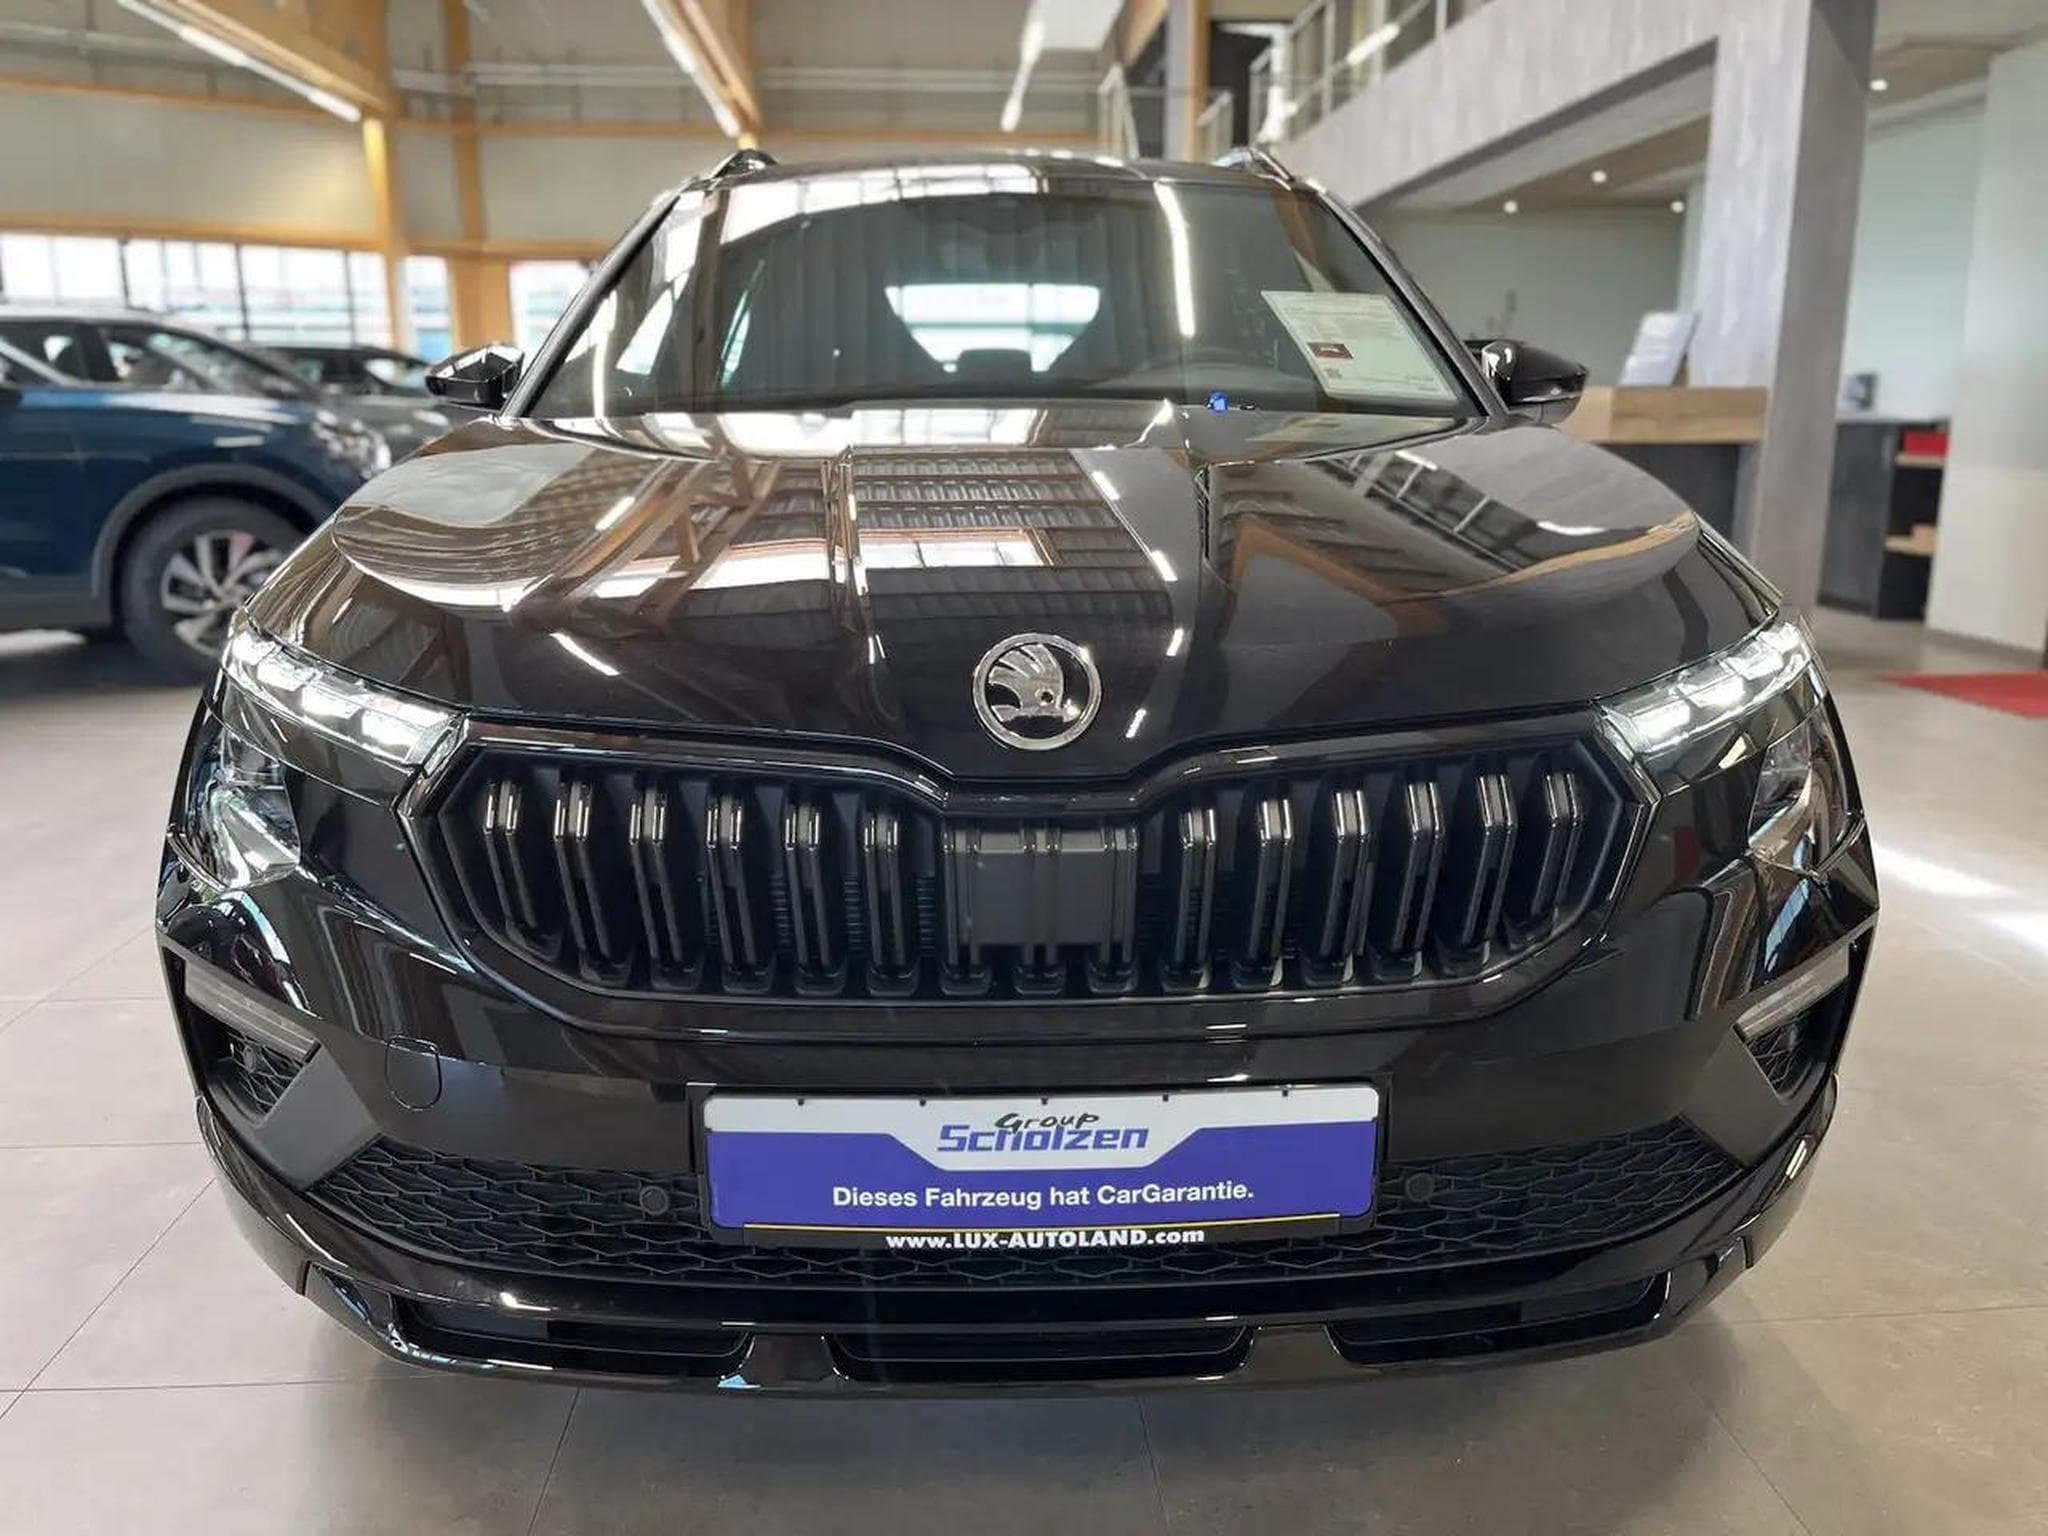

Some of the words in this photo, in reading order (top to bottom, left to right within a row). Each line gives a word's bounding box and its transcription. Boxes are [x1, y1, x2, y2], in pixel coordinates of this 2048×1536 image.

[995, 1112, 1100, 1135] Group
[937, 1124, 1149, 1152] Scholzen
[832, 1187, 918, 1208] Dieses
[925, 1187, 1042, 1210] Fahrzeug
[1050, 1186, 1090, 1206] hat
[1097, 1181, 1254, 1204] CarGarantie.
[885, 1229, 1205, 1250] www.LUX-AUTOLAND.com
